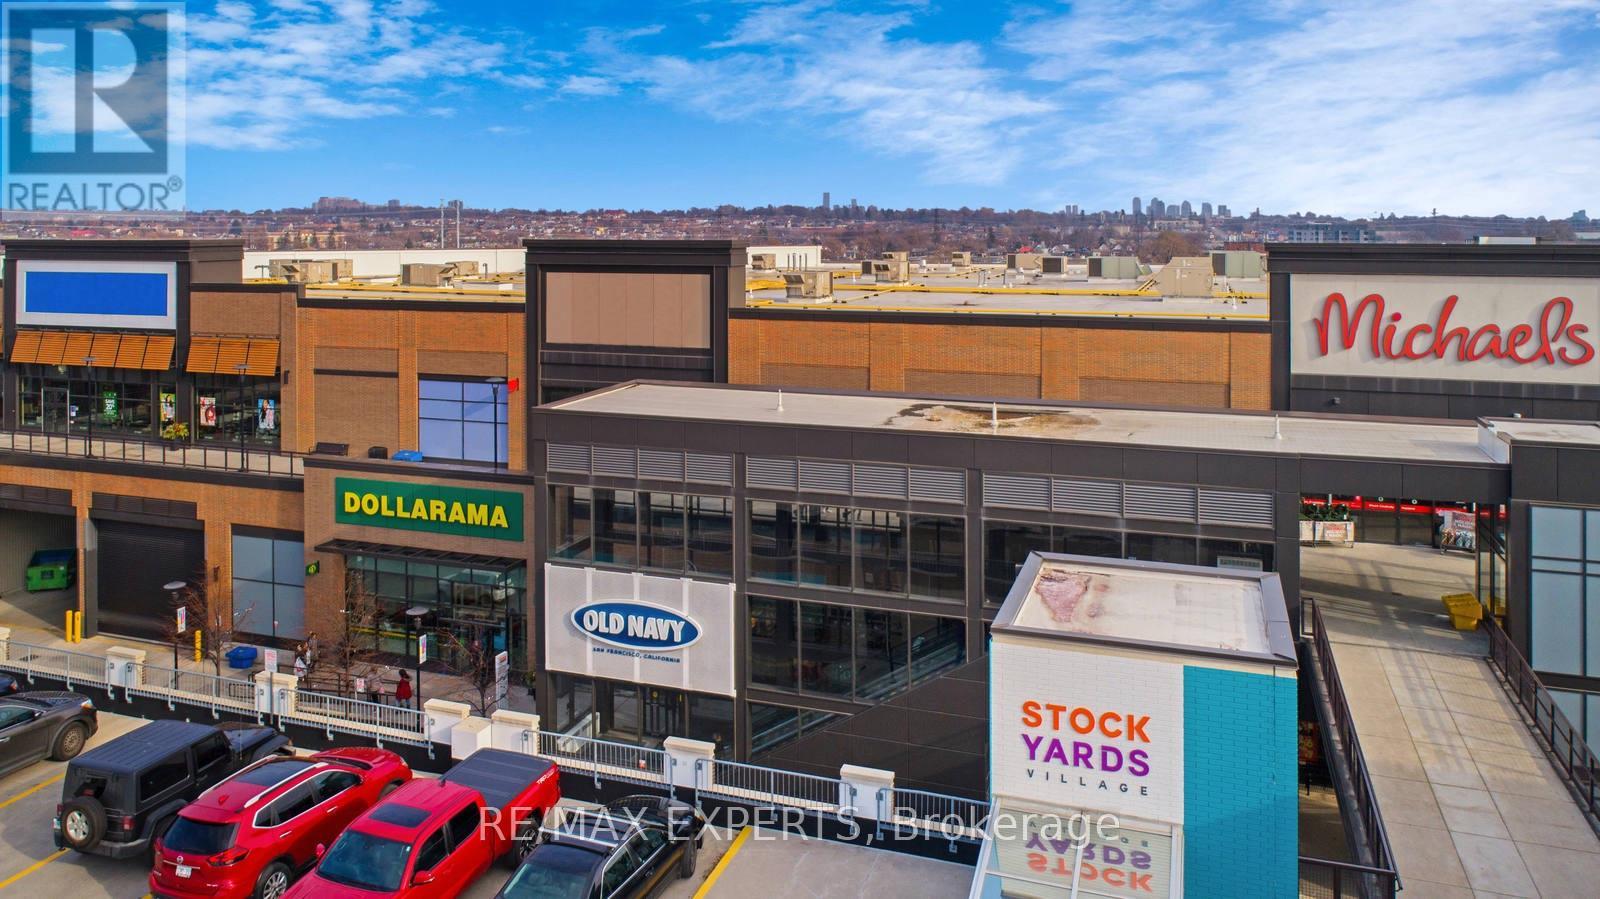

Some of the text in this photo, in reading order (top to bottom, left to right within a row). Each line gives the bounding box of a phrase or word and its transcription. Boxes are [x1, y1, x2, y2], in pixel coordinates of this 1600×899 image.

[1313, 292, 1595, 366] Michaels
[344, 491, 509, 528] DOLLARAMA
[583, 609, 686, 643] OLD NAVY
[643, 653, 681, 664] CALIFORNIA
[1021, 700, 1152, 744] STOCK
[1021, 733, 1150, 777] YARDS
[1027, 768, 1149, 796] VILLAGE
